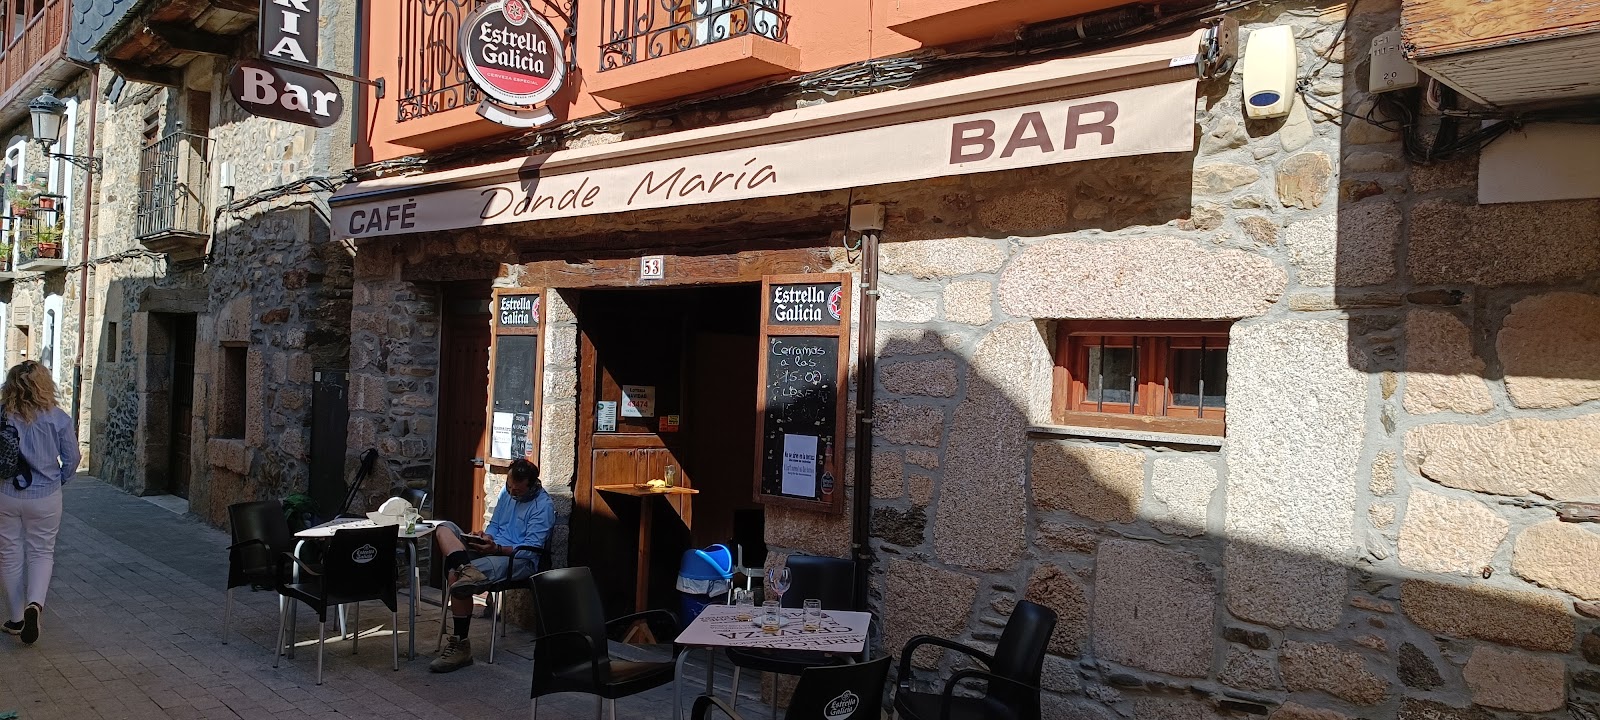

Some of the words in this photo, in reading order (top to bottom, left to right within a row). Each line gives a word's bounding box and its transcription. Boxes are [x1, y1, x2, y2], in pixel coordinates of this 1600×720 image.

[479, 21, 548, 55] Estrella
[482, 43, 545, 74] Galicia
[513, 76, 539, 86] ESPECIAL
[240, 66, 337, 117] Bar
[349, 198, 417, 236] CAFÉ
[627, 156, 778, 206] María
[949, 100, 1119, 164] BAR
[644, 260, 659, 275] 53
[773, 285, 825, 304] Estrella
[500, 297, 531, 311] Estrella
[501, 310, 529, 325] Galicia
[775, 303, 823, 322] Galicia
[772, 340, 826, 356] Cerramos
[780, 359, 790, 367] a
[794, 355, 817, 367] las
[830, 698, 856, 709] Estrella
